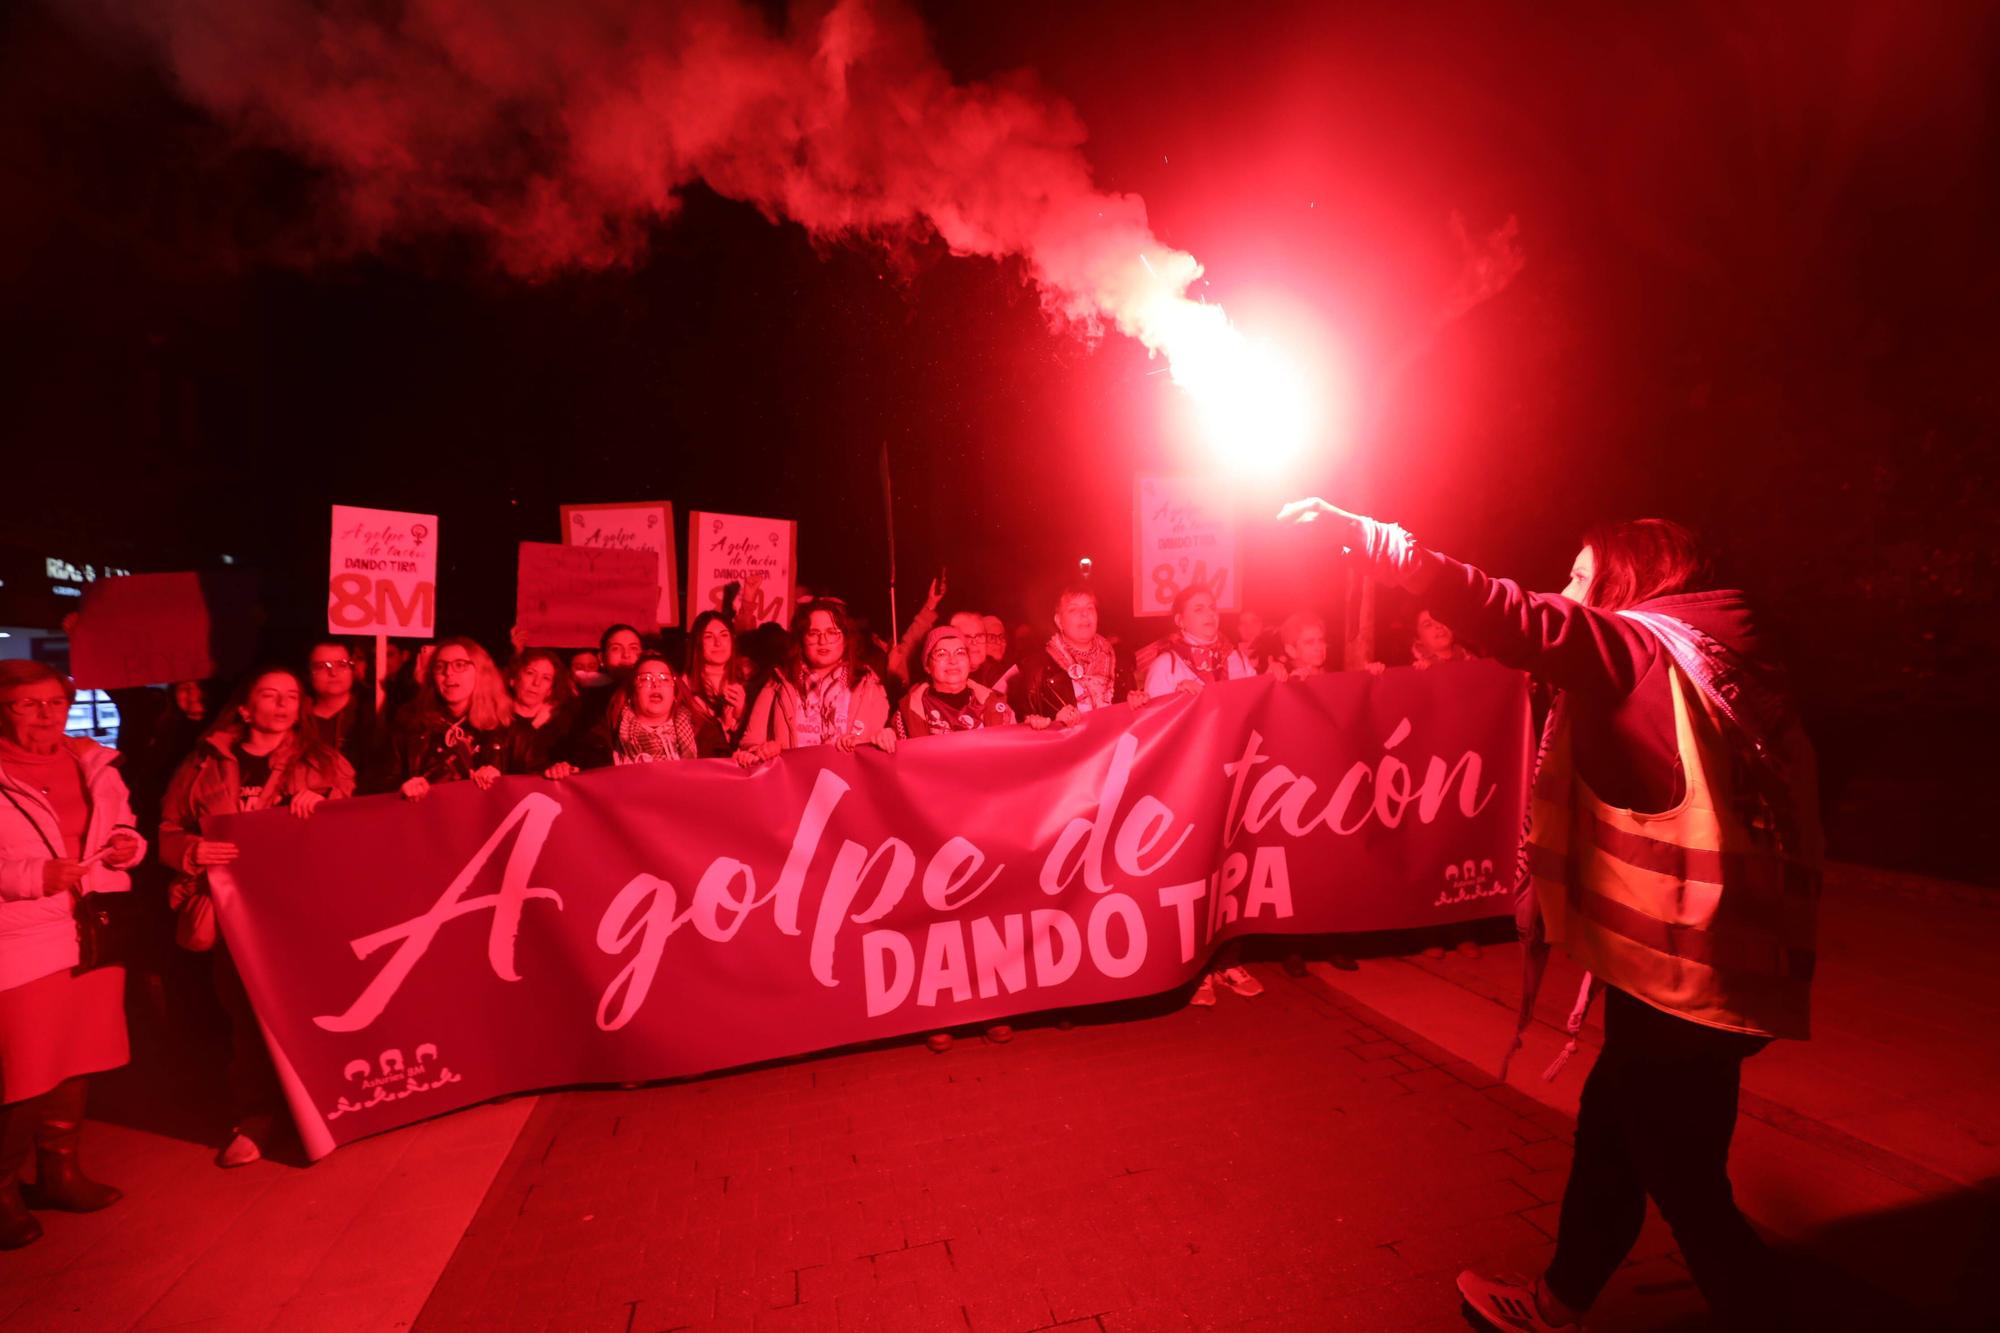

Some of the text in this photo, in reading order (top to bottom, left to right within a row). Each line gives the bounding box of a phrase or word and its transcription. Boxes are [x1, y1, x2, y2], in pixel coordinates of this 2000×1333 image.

[341, 523, 365, 540] A
[584, 528, 635, 547] A golpe
[710, 536, 760, 556] A golpe
[345, 558, 417, 572] DANDO TIRA
[729, 552, 777, 566] de tacón
[713, 568, 747, 579] DANDO
[328, 573, 434, 628] 8M
[312, 717, 1497, 1033] A golpe de tacón
[862, 846, 1294, 1018] DANDO TIRA
